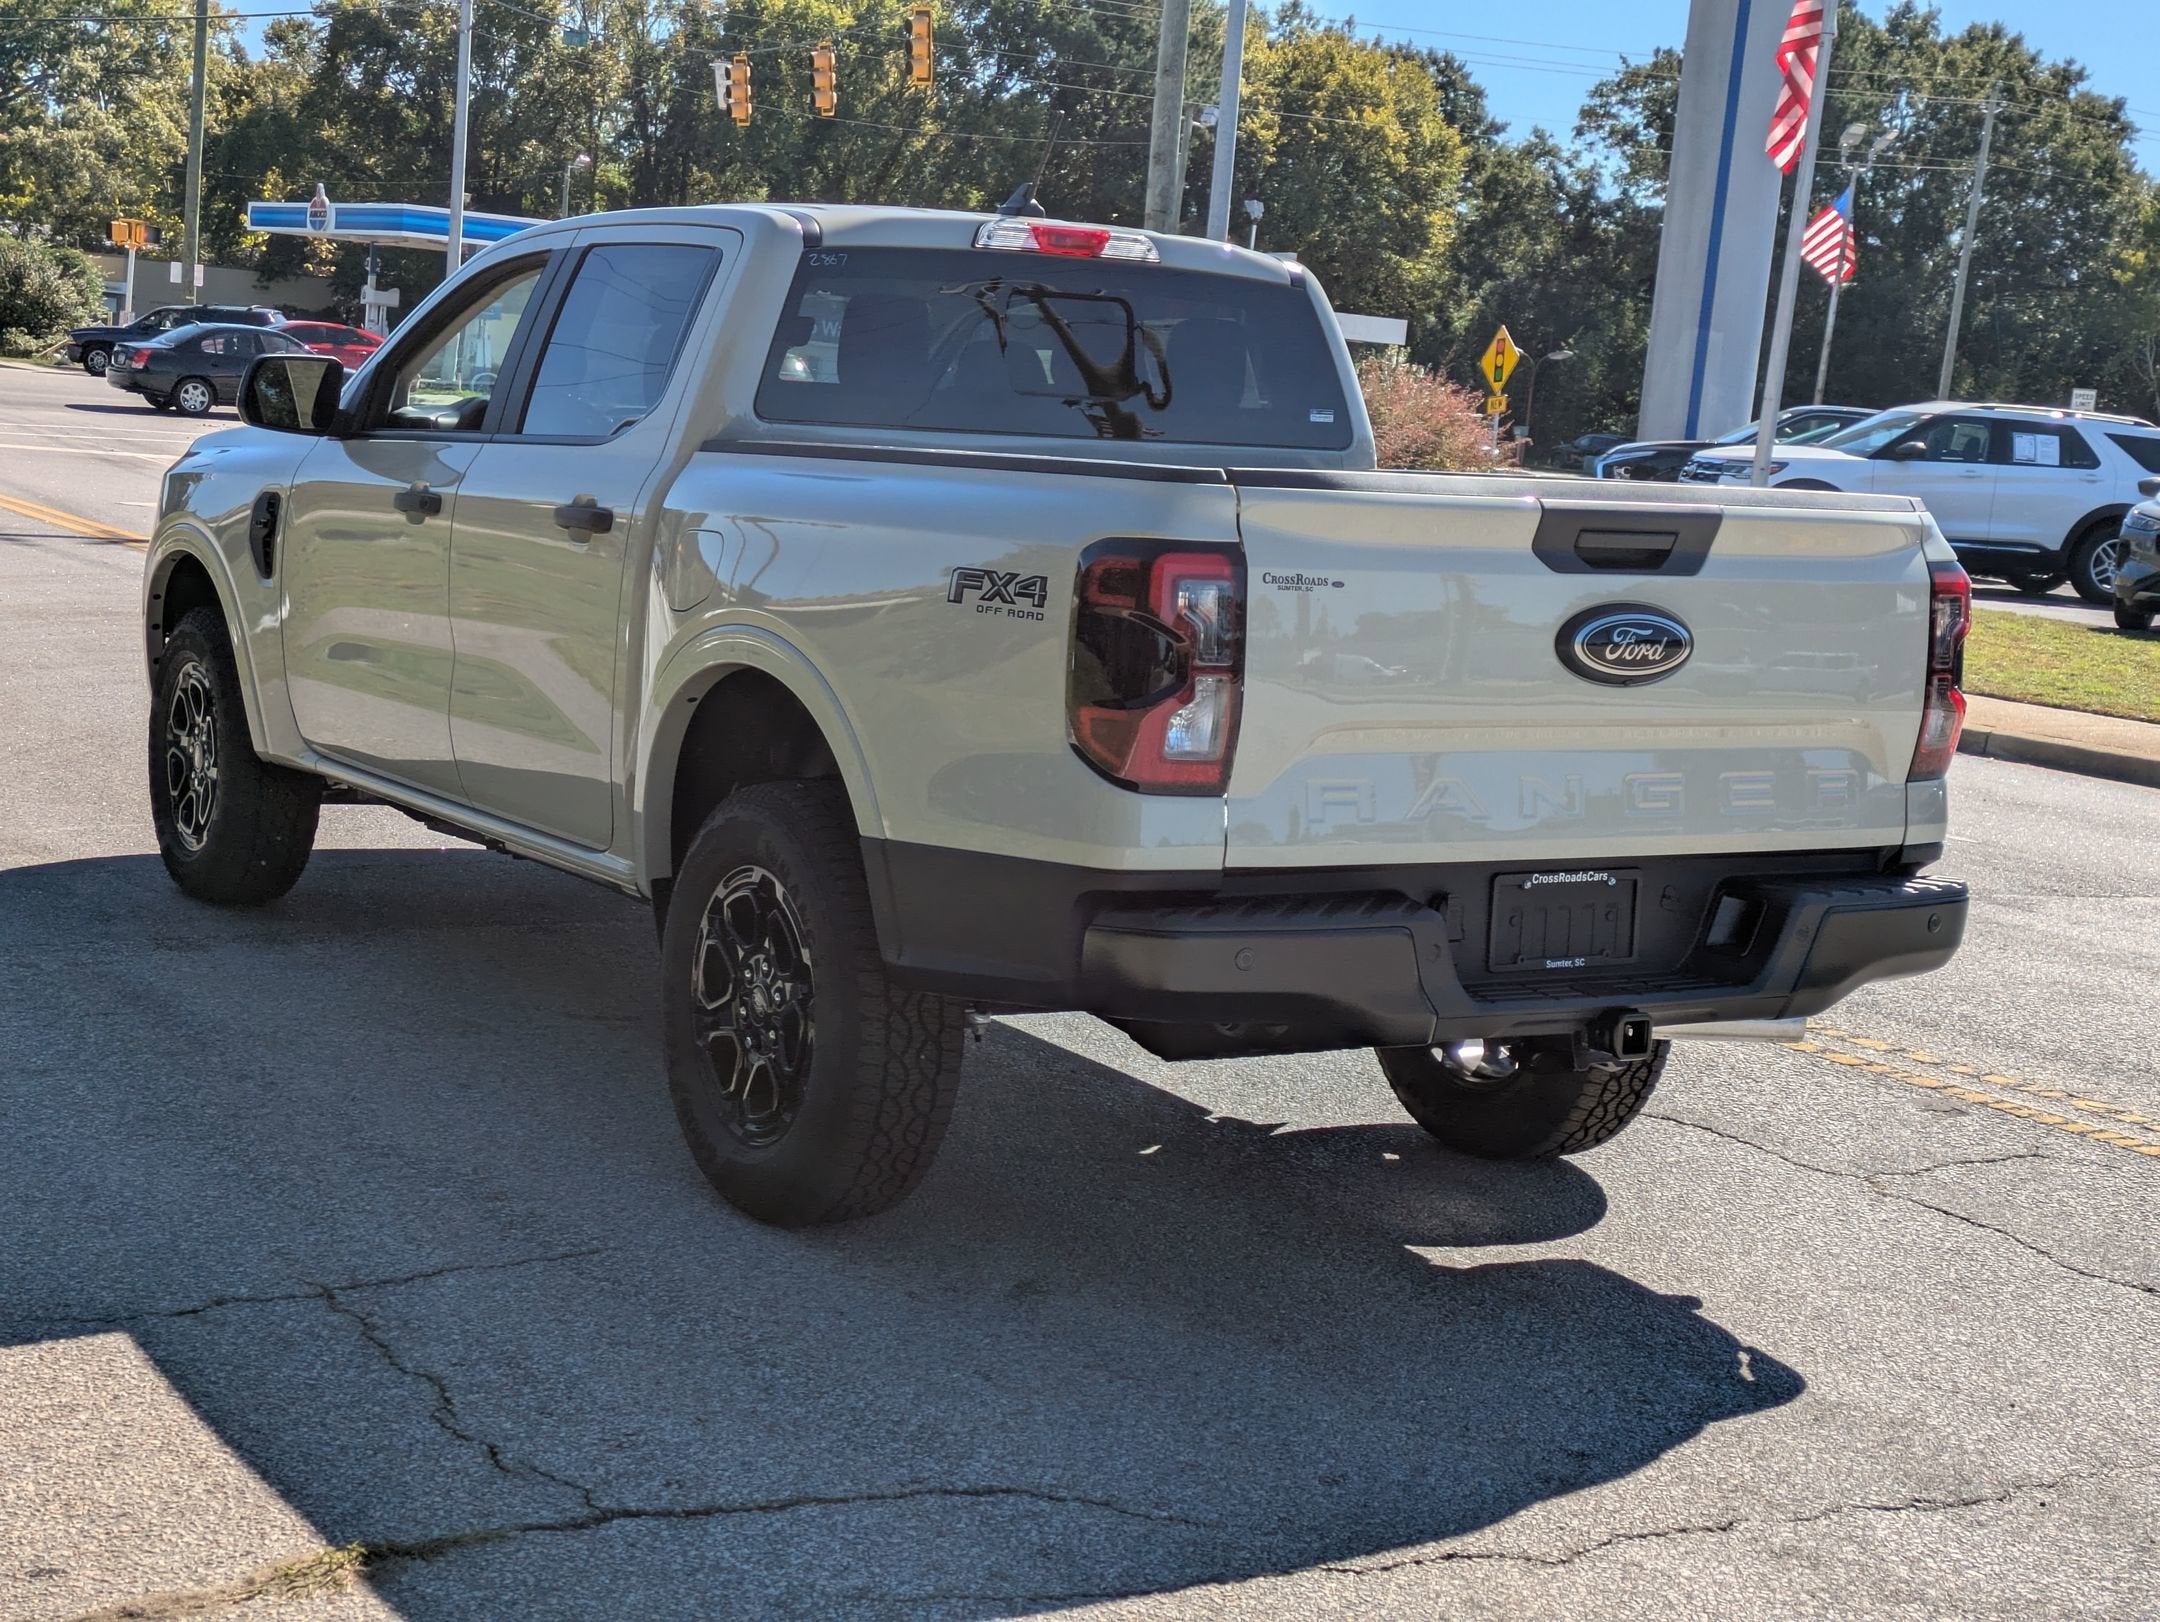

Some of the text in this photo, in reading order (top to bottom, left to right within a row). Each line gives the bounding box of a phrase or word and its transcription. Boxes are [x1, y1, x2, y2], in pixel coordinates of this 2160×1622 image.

[947, 566, 1048, 608] FX4
[976, 604, 1044, 621] OFF ROAD
[1605, 626, 1668, 660] Ford
[1305, 769, 1857, 824] RANGER
[1532, 871, 1609, 884] CrossRoadsCars
[1546, 958, 1586, 968] Sumter, SC
